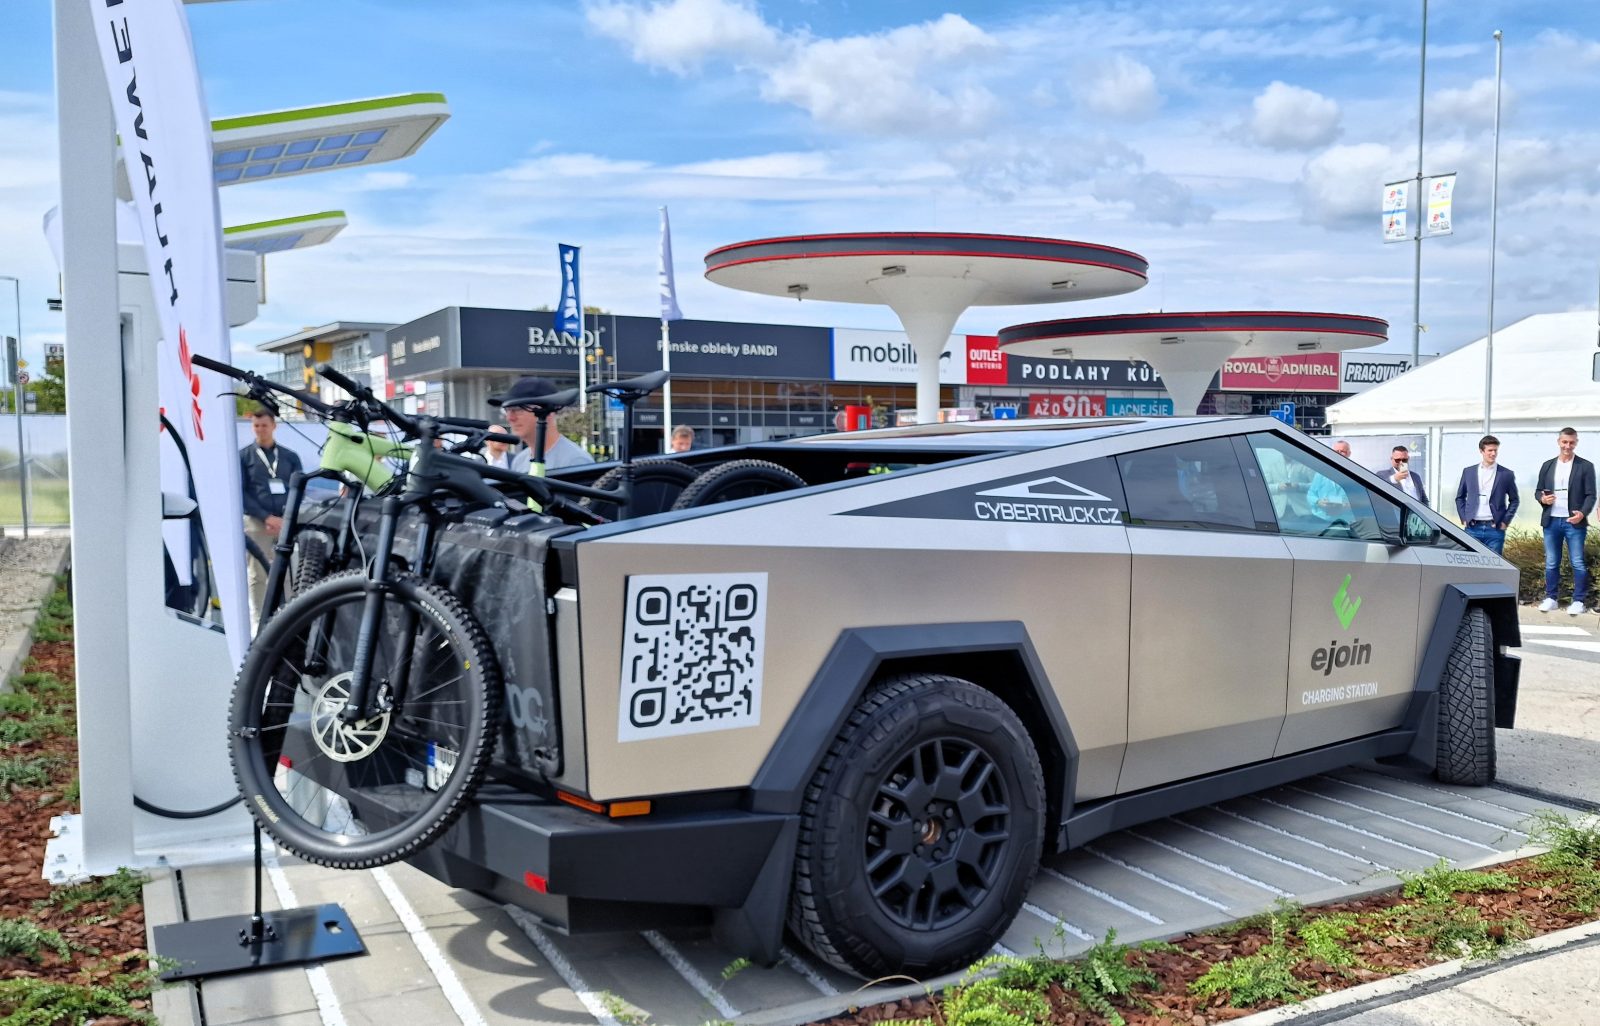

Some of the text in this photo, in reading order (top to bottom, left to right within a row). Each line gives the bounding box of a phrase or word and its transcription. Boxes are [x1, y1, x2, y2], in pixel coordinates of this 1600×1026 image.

[700, 342, 739, 357] obleky
[742, 344, 778, 356] BANDI
[970, 349, 1002, 361] OUTLET
[1022, 364, 1110, 381] PODLAHY
[1224, 361, 1337, 376] ROYAL ADMIRAL
[974, 501, 1123, 524] CYBERTRUCK.CZ
[1445, 552, 1503, 567] CYBERTRUCK.CZ
[1310, 638, 1372, 676] ejoin
[1302, 682, 1378, 705] CHARGING STATION
